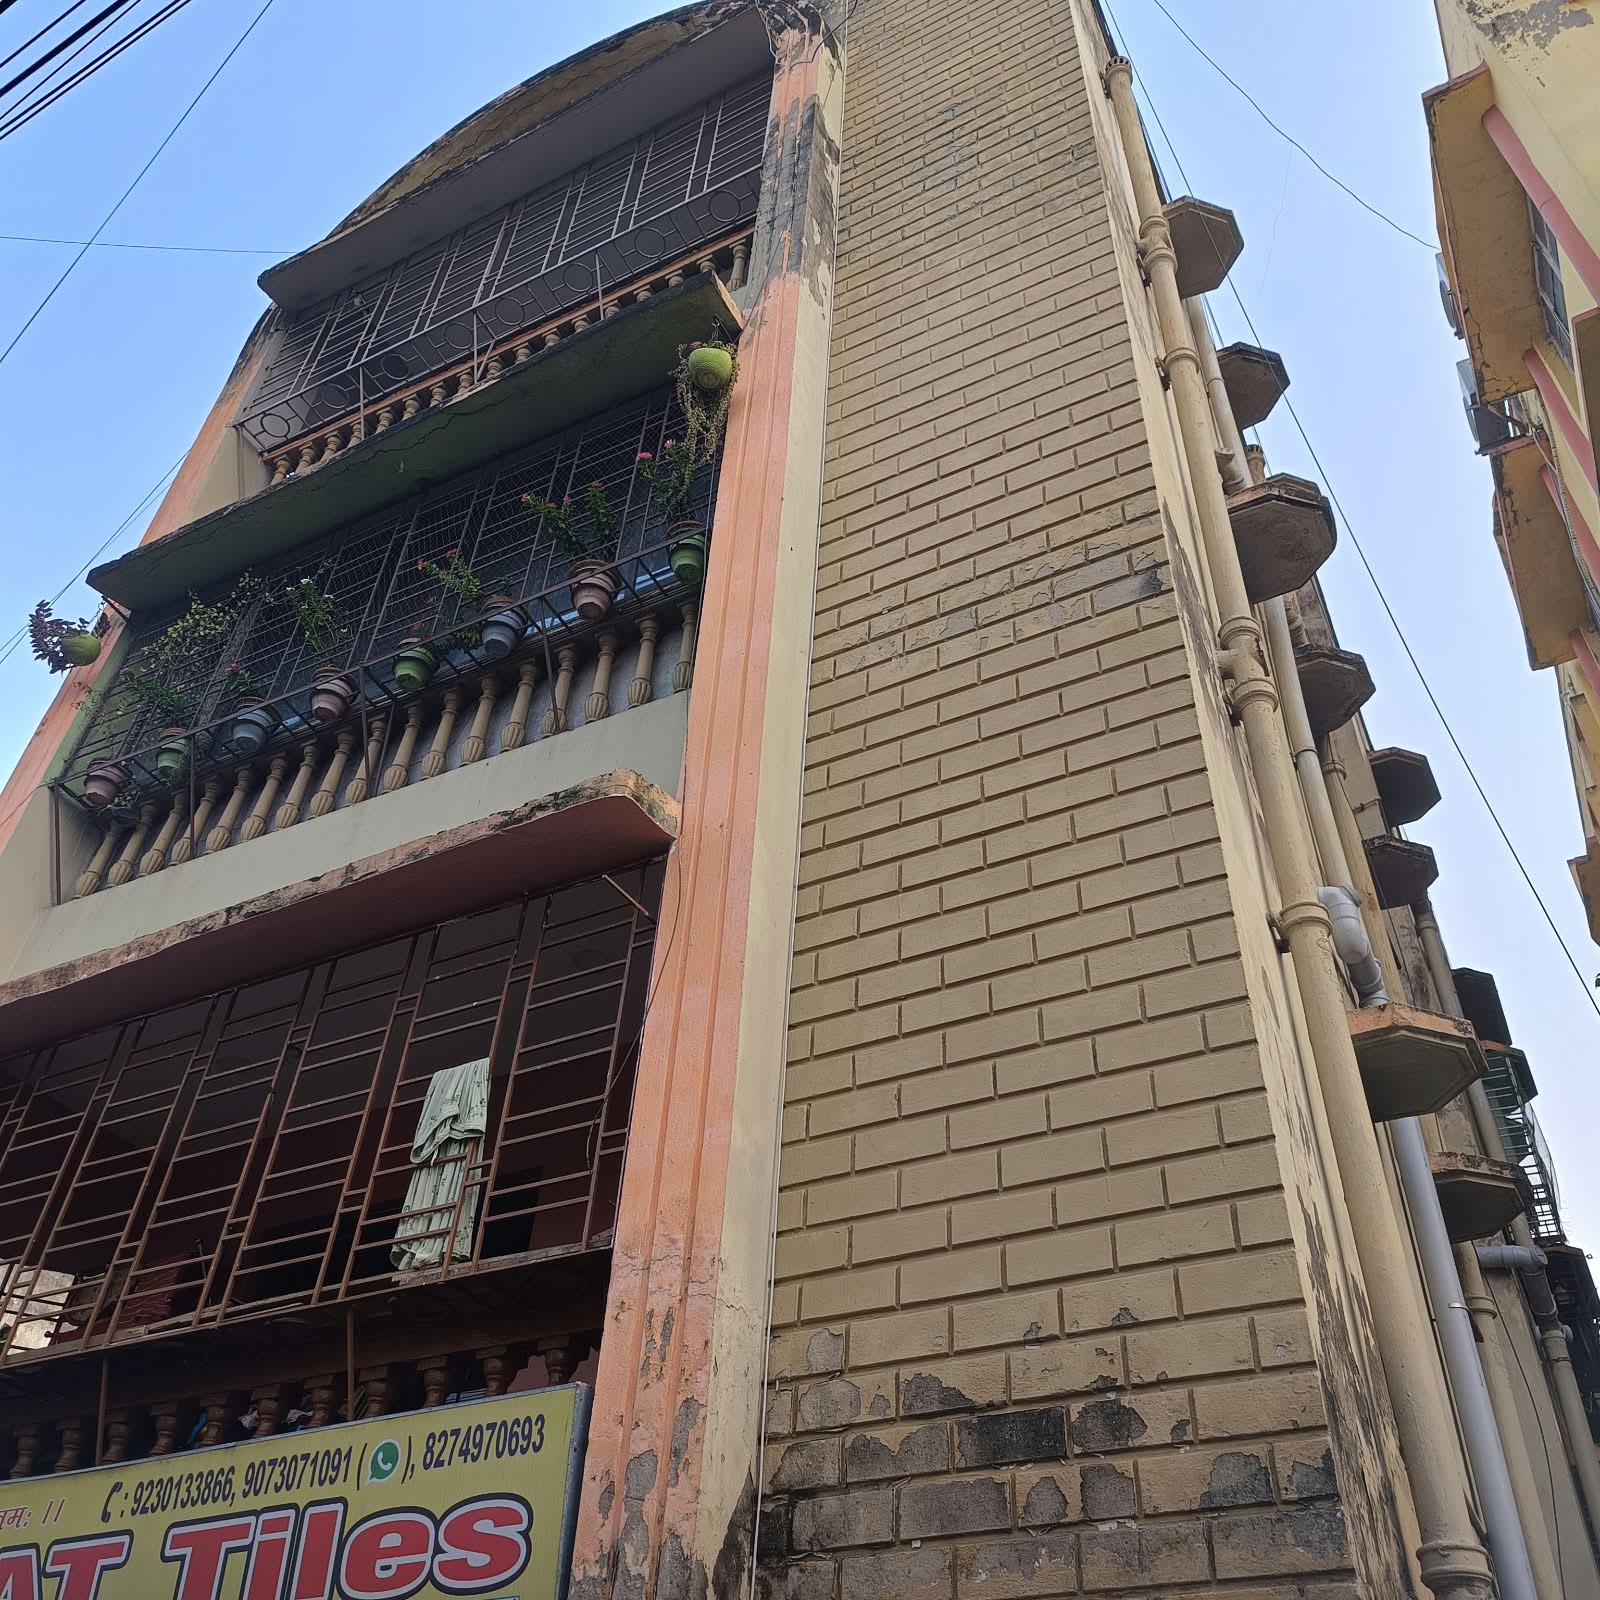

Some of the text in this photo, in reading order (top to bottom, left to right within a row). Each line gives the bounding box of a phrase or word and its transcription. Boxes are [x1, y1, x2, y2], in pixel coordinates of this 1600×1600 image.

[241, 1446, 353, 1499] 9073071091
[422, 1413, 546, 1471] 8274970693
[160, 1492, 534, 1600] Tiles
